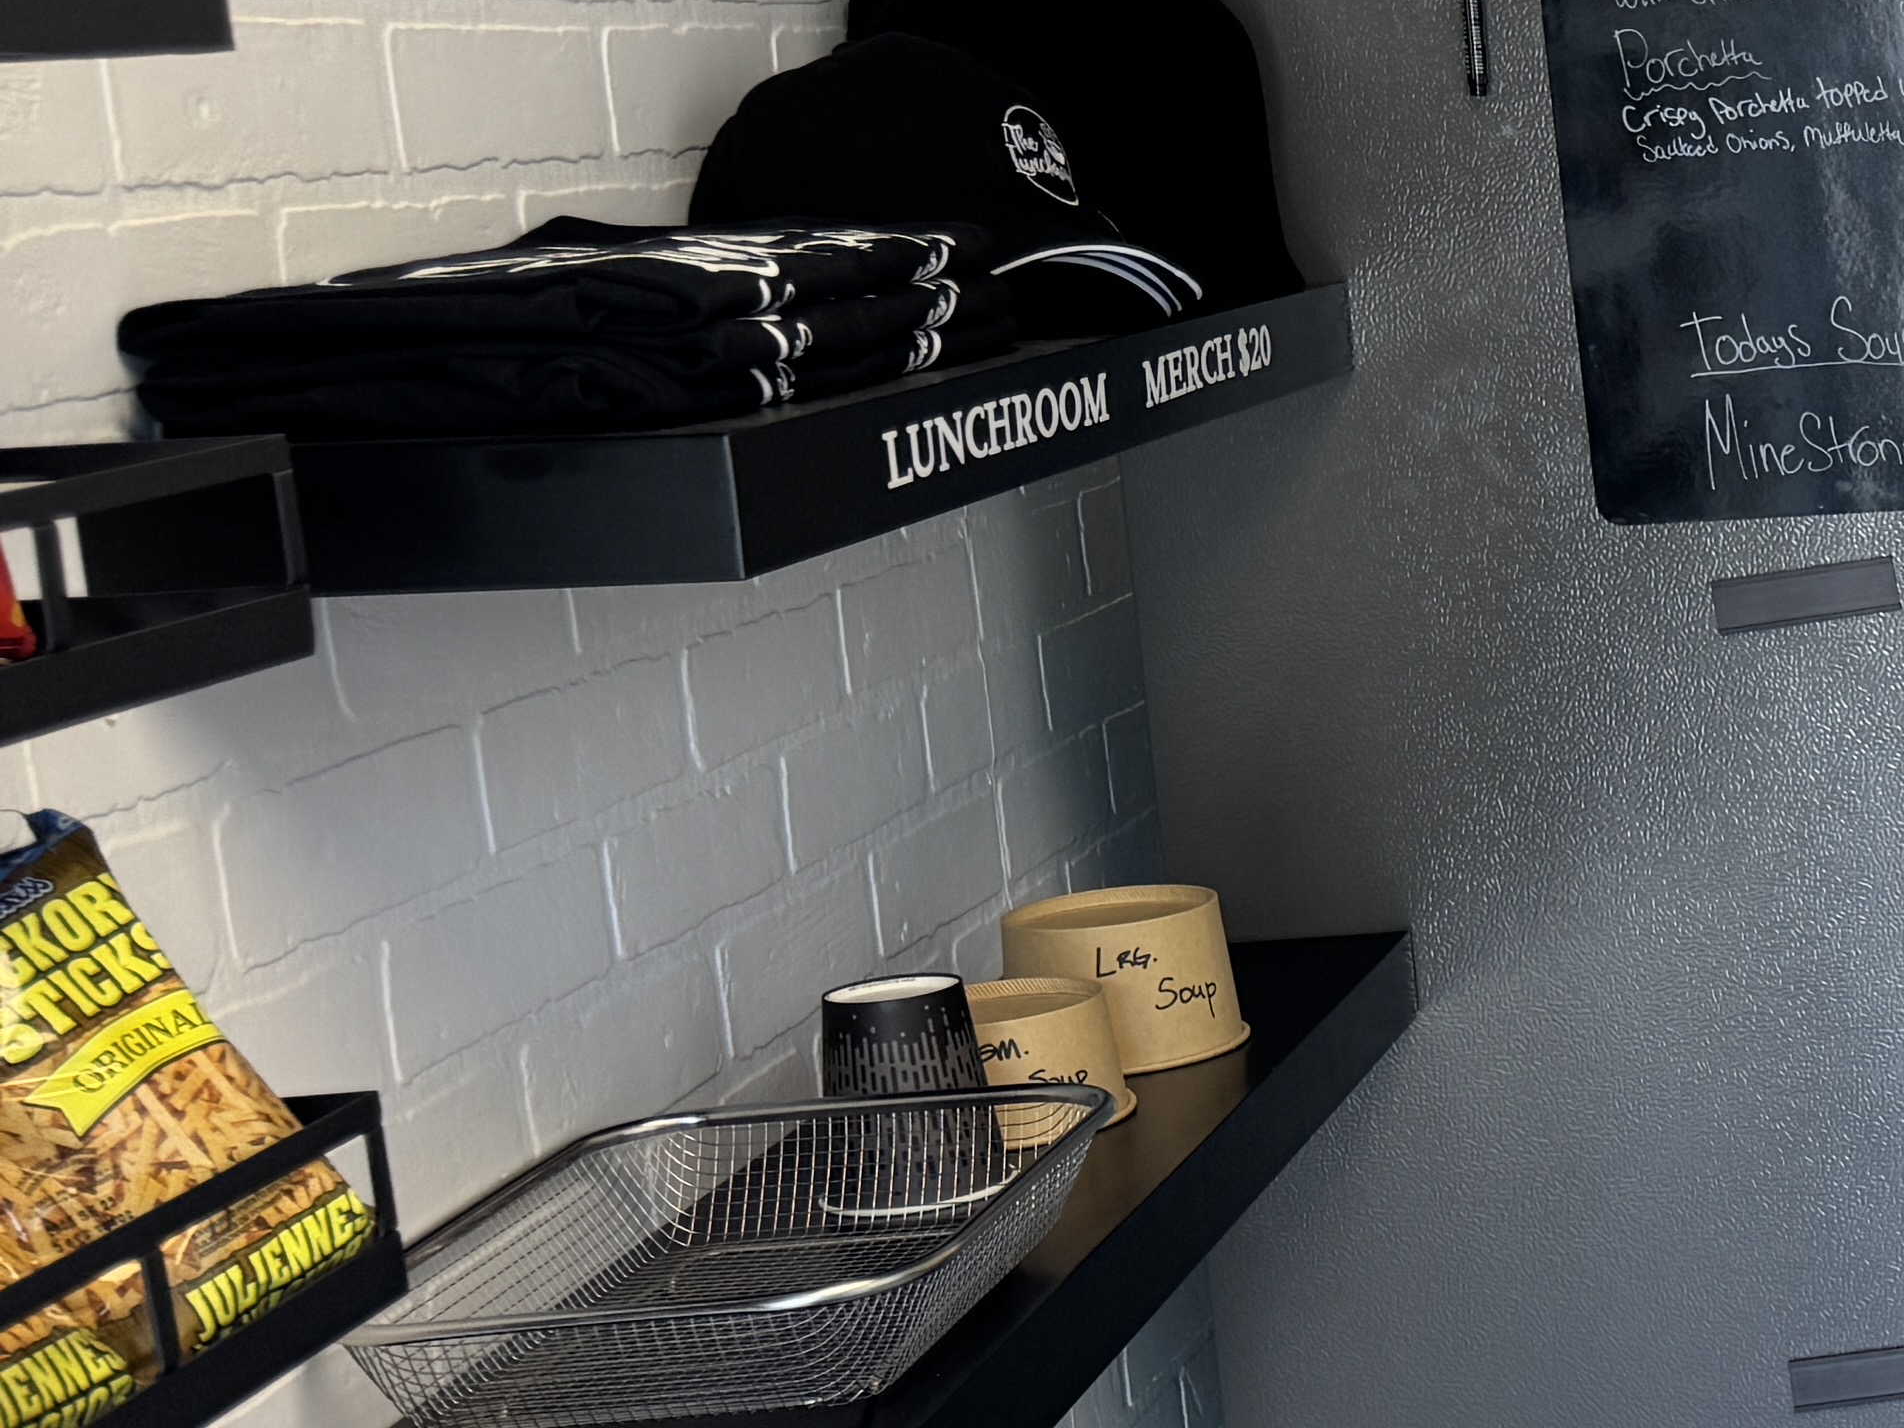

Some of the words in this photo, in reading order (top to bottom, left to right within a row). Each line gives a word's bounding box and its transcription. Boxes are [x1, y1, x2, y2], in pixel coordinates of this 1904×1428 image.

[1614, 28, 1763, 88] Porchetta
[1816, 76, 1889, 108] topped
[1001, 122, 1039, 156] The
[1680, 311, 1811, 371] Todays
[881, 372, 1110, 490] LUNCHROOM
[1142, 333, 1236, 409] MERCH
[1237, 324, 1273, 378] $20
[1155, 976, 1217, 1019] Soup
